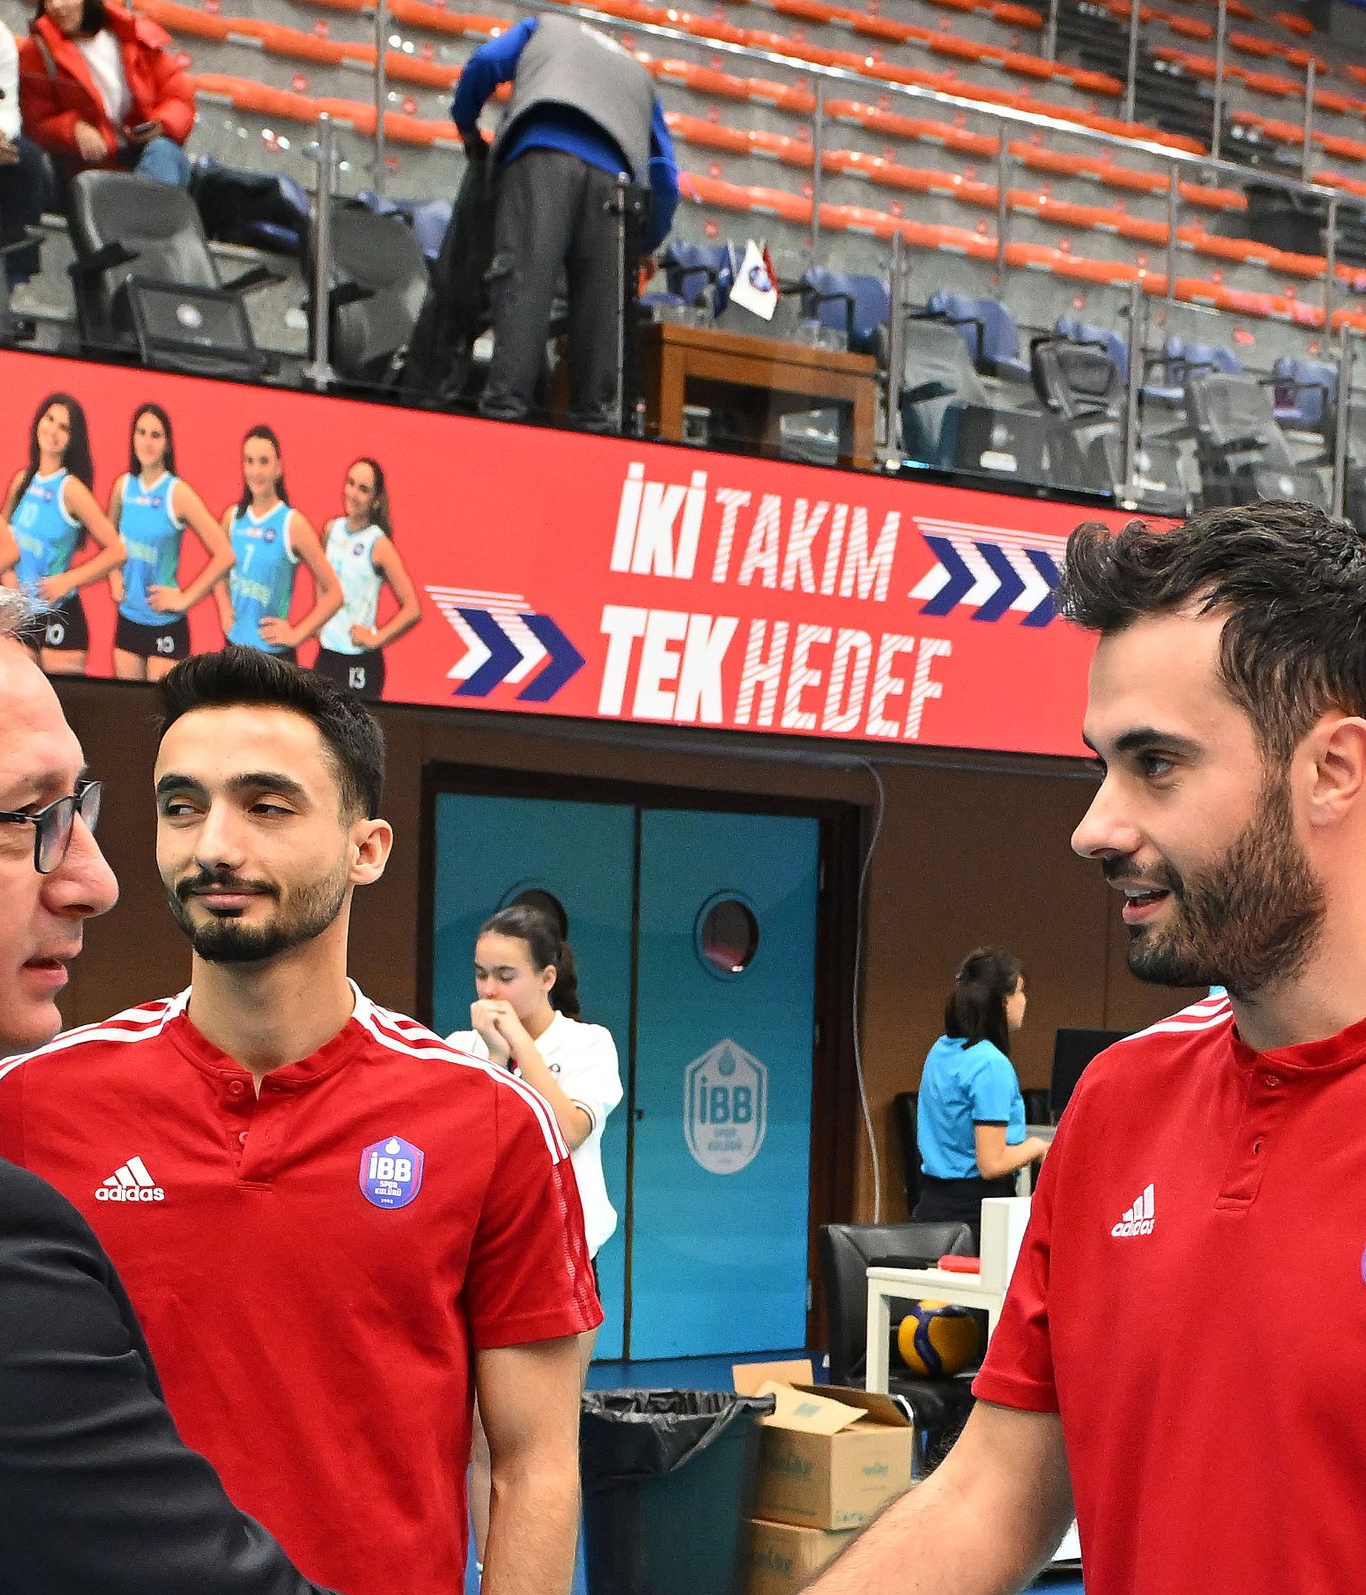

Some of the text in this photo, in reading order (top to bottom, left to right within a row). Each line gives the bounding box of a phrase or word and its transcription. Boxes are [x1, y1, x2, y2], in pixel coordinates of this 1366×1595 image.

[610, 462, 901, 601] İKİ TAKIM
[596, 605, 952, 740] TEK HEDEF
[699, 1076, 753, 1125] İBB
[369, 1152, 412, 1182] İBB
[95, 1184, 165, 1202] adidas
[1110, 1217, 1156, 1238] adidas
